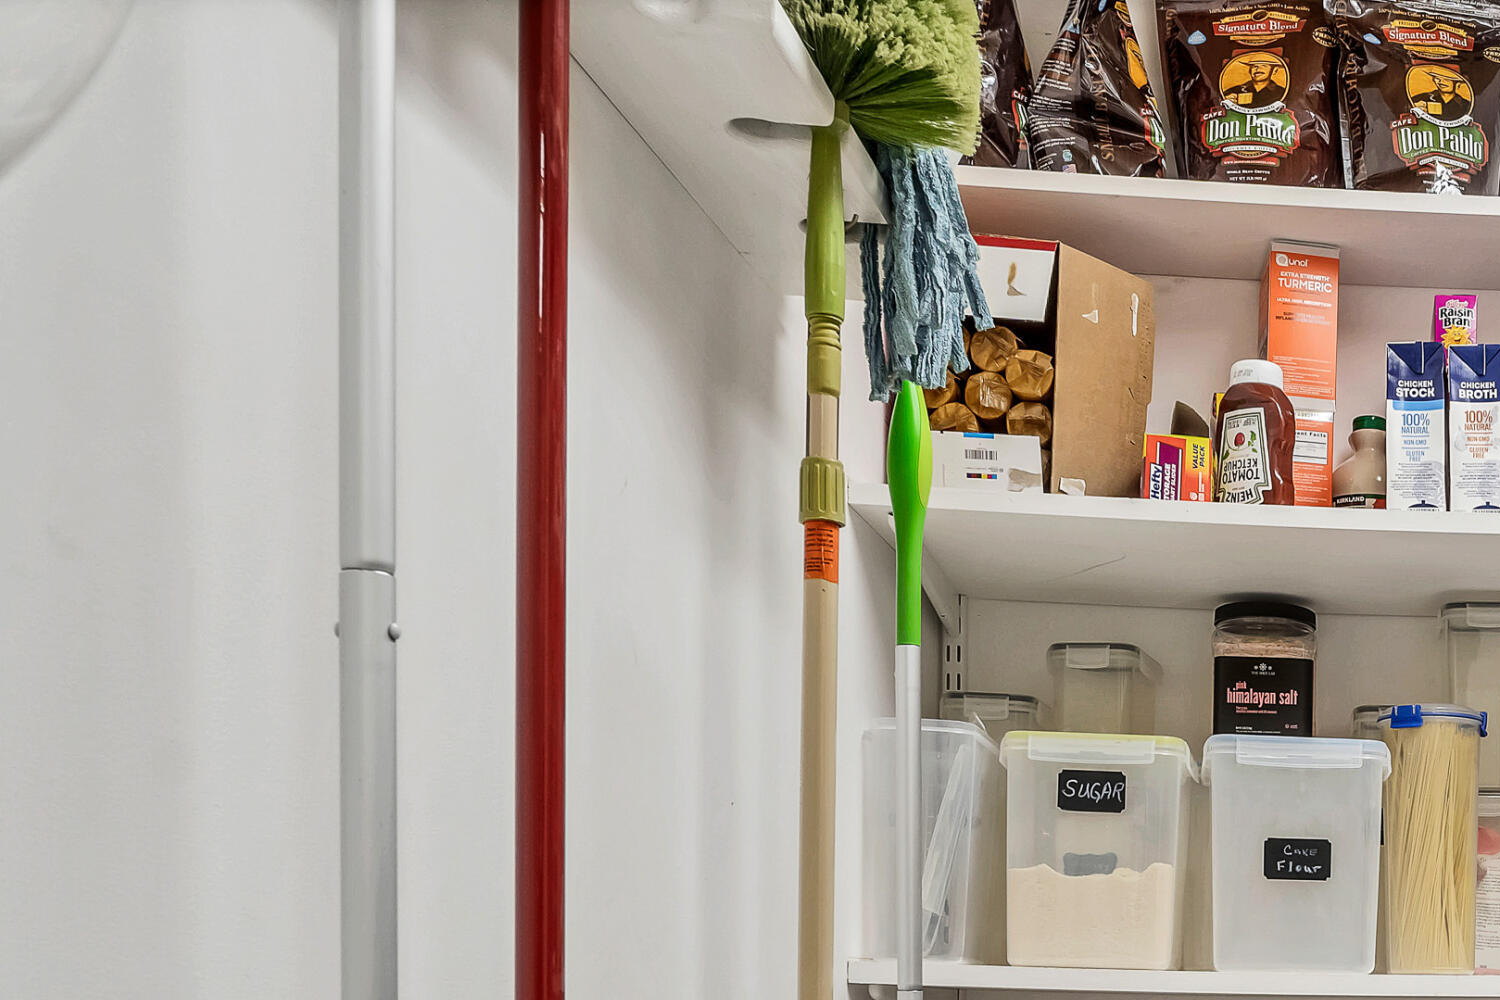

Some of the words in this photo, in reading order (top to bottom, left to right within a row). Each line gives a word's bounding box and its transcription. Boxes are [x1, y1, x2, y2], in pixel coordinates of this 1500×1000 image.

[1218, 22, 1266, 33] Signature
[1269, 21, 1298, 31] Blend
[1389, 27, 1436, 41] Signature
[1439, 29, 1467, 48] Blend
[1203, 110, 1223, 121] CAFE
[1392, 117, 1413, 129] CAFE
[1209, 119, 1241, 143] Don
[1400, 127, 1433, 155] Don
[1438, 126, 1483, 160] Pablo
[1276, 253, 1308, 267] Qunol
[1277, 277, 1332, 293] TURMERIC
[1440, 308, 1474, 319] Raisin
[1444, 318, 1470, 327] Bran
[1460, 381, 1495, 389] CHICKEN
[1395, 387, 1435, 398] STOCK
[1458, 389, 1497, 399] BROTH
[1401, 413, 1430, 426] 100%
[1464, 410, 1493, 424] 100%
[1401, 426, 1429, 434] NATURAL
[1464, 422, 1492, 431] NATURAL
[1224, 458, 1258, 472] KETCHUP
[1150, 465, 1163, 499] Hefty
[1222, 468, 1260, 485] TOMATO
[1226, 487, 1254, 503] HEINZ
[1226, 687, 1277, 708] himalayan
[1279, 689, 1298, 705] salt
[1062, 777, 1125, 804] SUGAR
[1277, 860, 1322, 873] Flour
